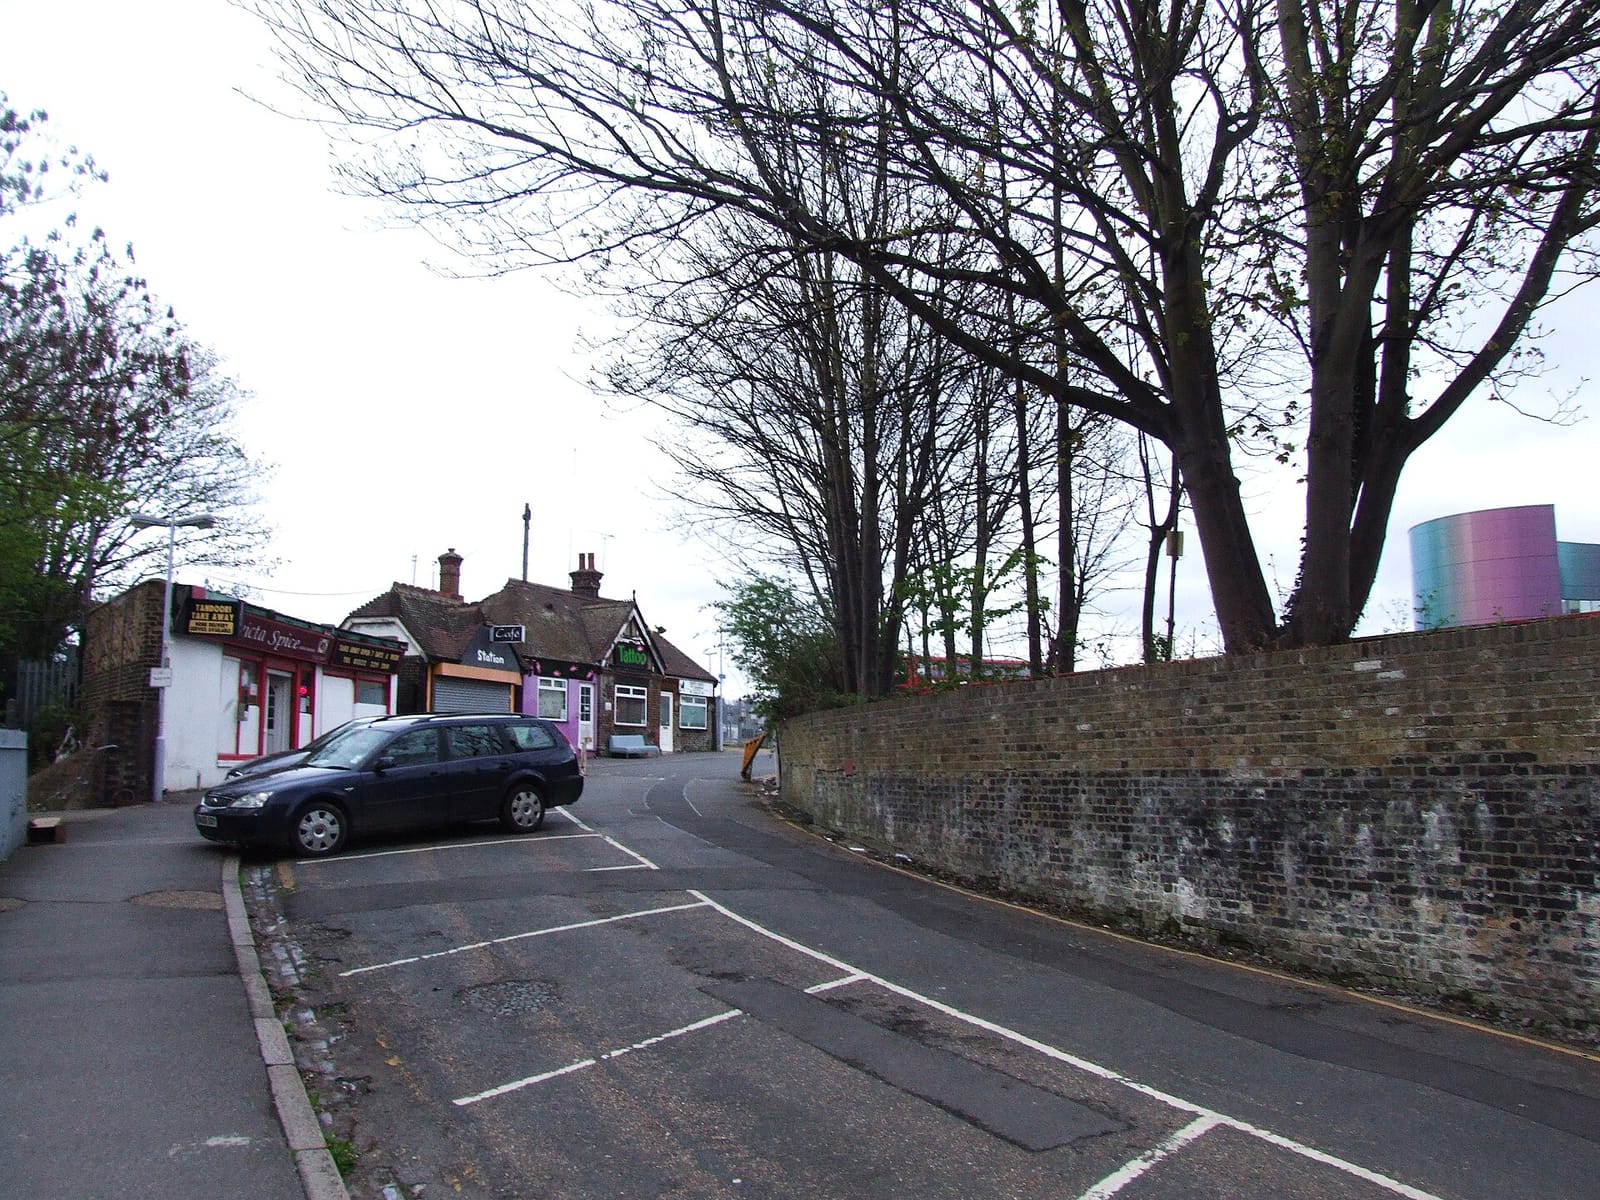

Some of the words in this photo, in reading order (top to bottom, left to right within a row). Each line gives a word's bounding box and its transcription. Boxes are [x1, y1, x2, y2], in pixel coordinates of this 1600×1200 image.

[195, 604, 233, 613] TANDOORI
[191, 612, 209, 620] TAKE
[211, 613, 234, 621] AWAY
[266, 630, 301, 651] Spice
[477, 650, 505, 664] Station
[617, 645, 647, 665] Tattoo
